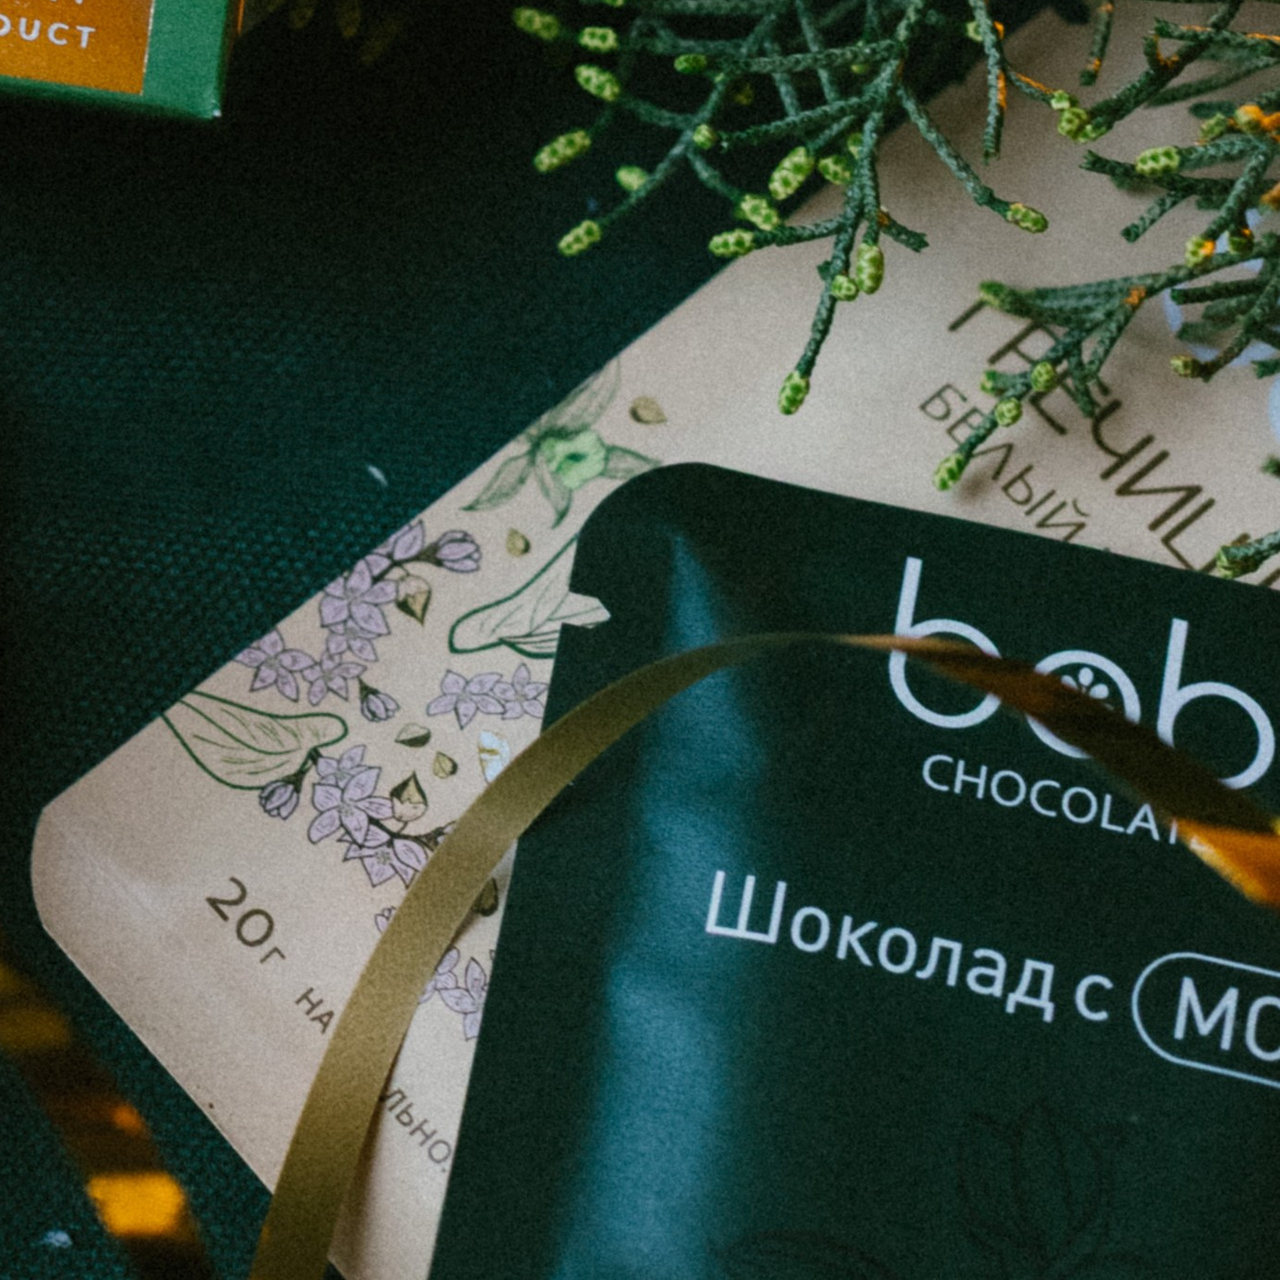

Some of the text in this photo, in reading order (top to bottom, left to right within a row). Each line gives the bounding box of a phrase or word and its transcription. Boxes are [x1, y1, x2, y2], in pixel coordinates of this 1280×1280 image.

[922, 754, 1215, 854] CHOCOLA
[206, 877, 287, 966] 20г
[705, 870, 1056, 1023] Шоколад
[1074, 973, 1115, 1021] с
